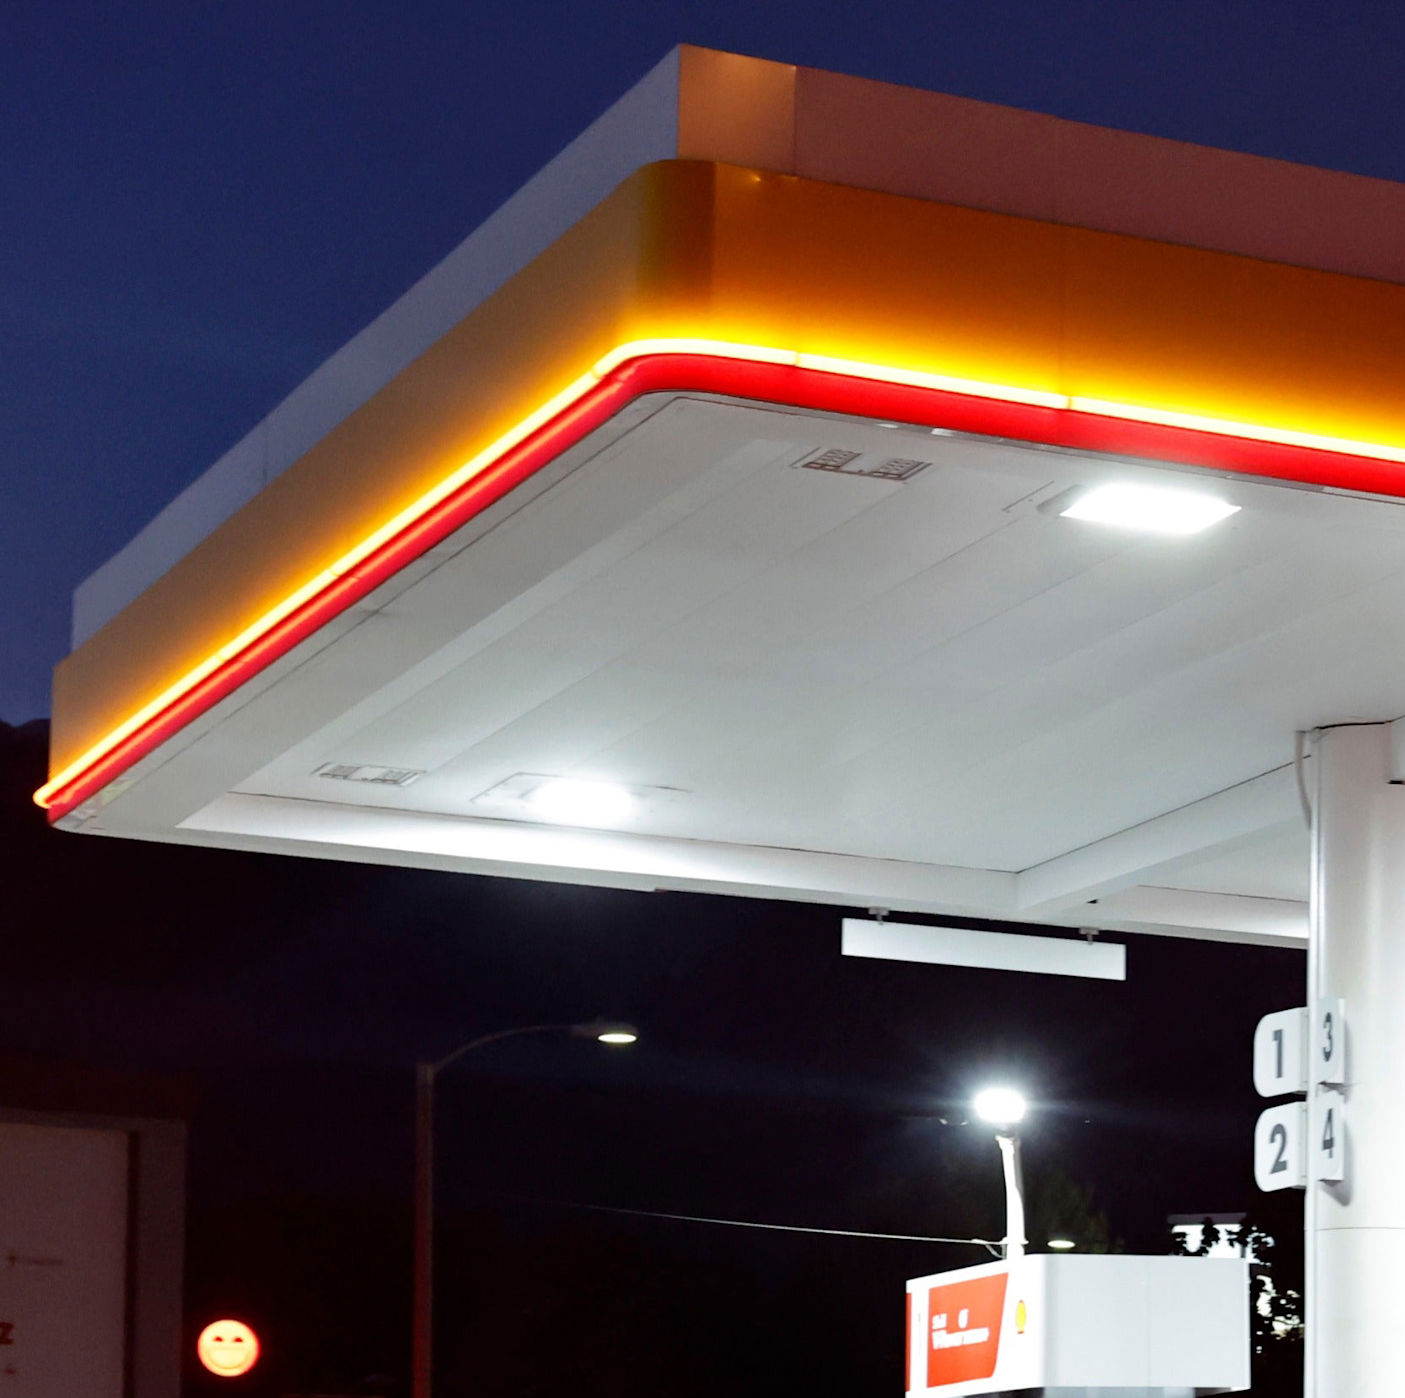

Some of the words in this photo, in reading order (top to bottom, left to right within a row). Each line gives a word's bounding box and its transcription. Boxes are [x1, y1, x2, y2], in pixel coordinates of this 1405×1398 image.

[1272, 1029, 1283, 1079] 1
[1322, 1012, 1333, 1062] 3
[1269, 1123, 1288, 1174] 2
[1322, 1108, 1334, 1159] 4
